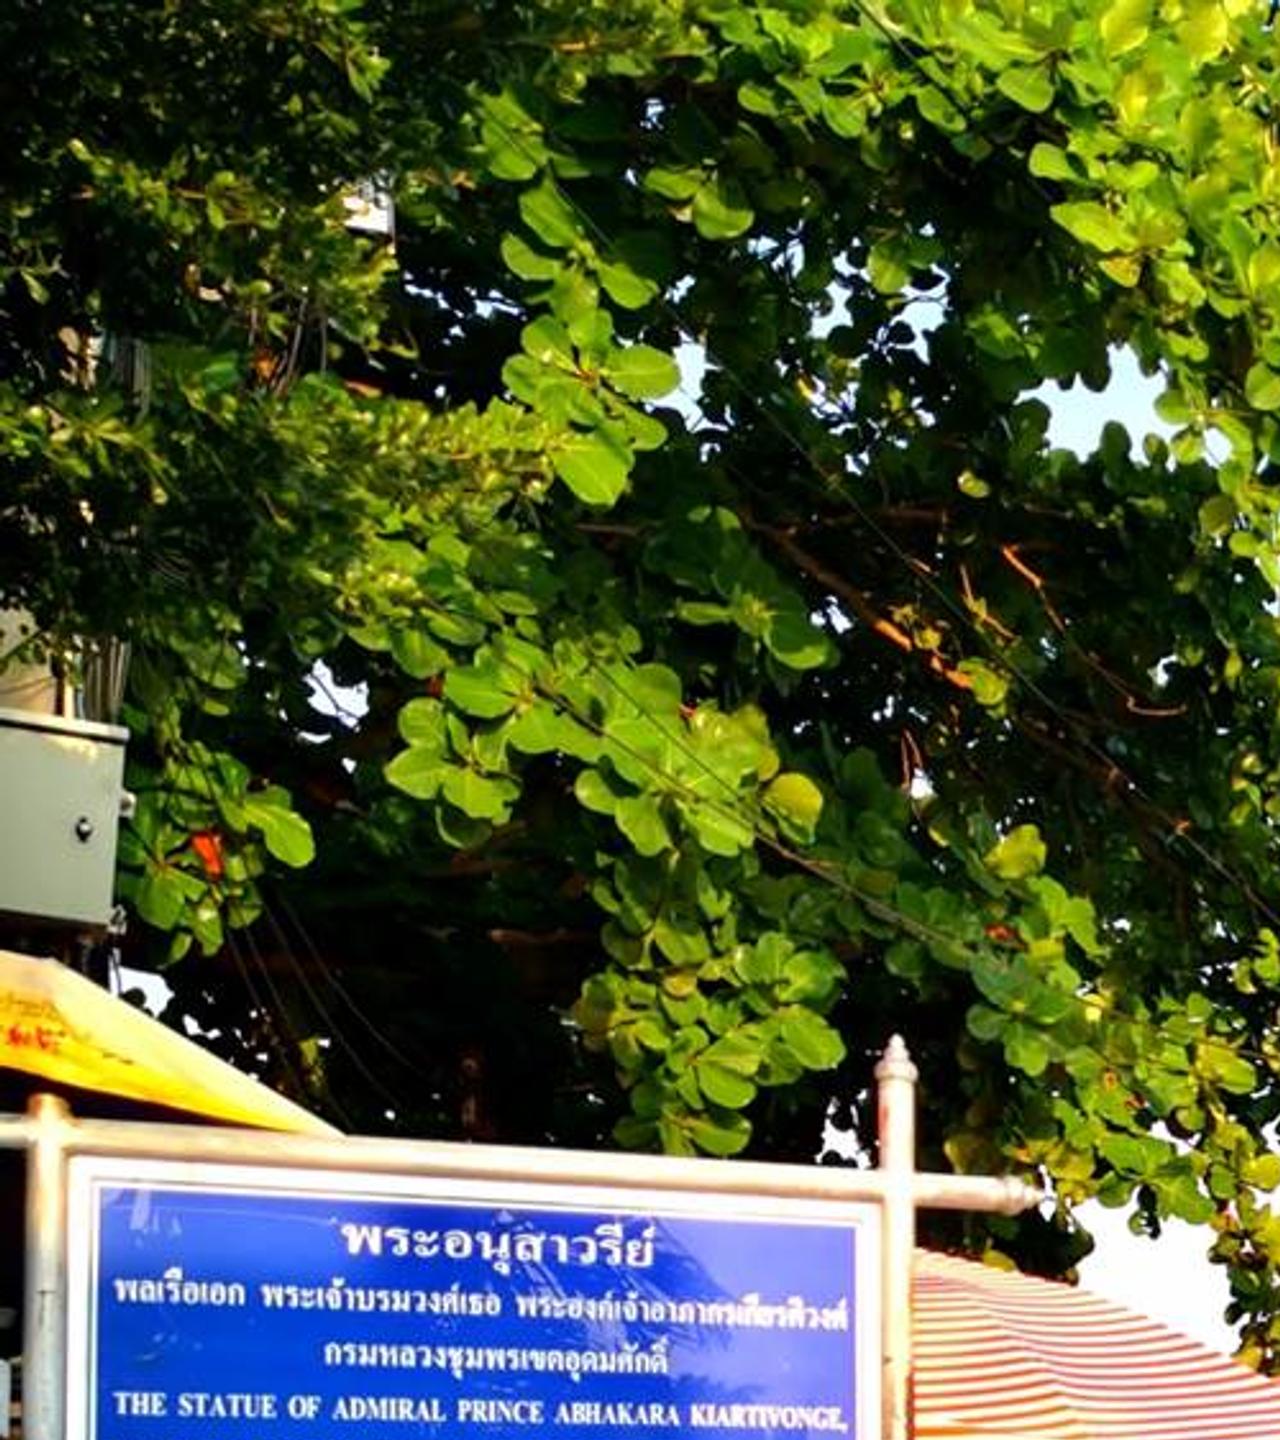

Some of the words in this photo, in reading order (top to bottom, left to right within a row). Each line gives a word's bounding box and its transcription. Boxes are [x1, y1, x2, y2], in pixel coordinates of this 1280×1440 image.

[340, 1222, 656, 1277] พระอนุสาวรีย์
[113, 1266, 246, 1307] พลเรือเอก
[261, 1277, 502, 1316] พระเจ้าบรมวงศ์เธอ
[324, 1335, 669, 1382] กรมหลวงชุมพรเขตอุดมศักดิ์
[113, 1391, 168, 1419] THE
[177, 1393, 278, 1420] STATUE
[287, 1395, 322, 1422] OF
[331, 1398, 447, 1423] ADMIRAL
[456, 1399, 545, 1425] PRINCE
[555, 1402, 681, 1428] ABHAKARA
